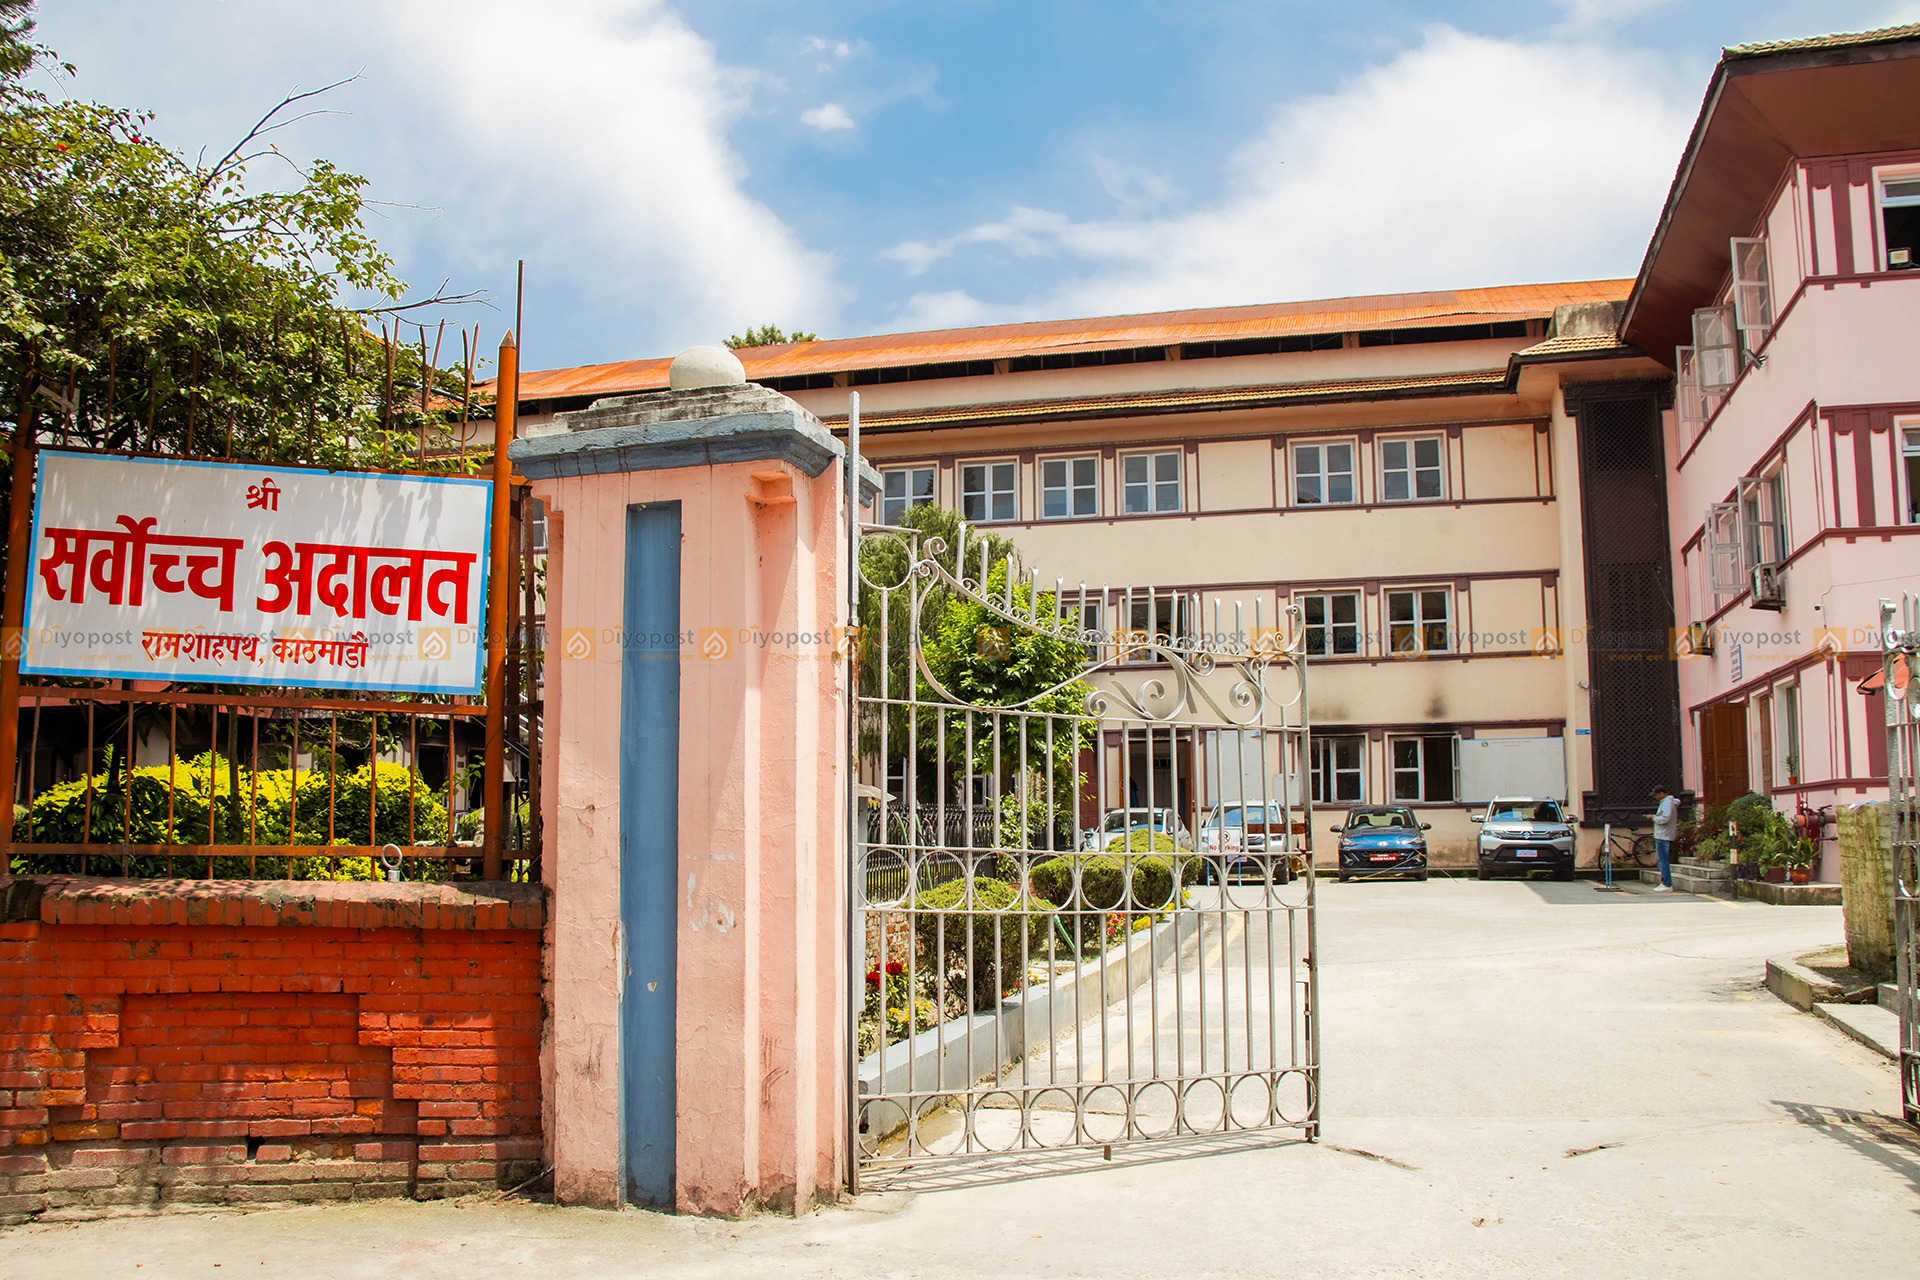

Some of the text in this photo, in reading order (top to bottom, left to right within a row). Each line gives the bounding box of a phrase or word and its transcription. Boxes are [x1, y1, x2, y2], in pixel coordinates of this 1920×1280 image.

[246, 477, 281, 511] श्री
[40, 515, 477, 625] सर्वोच्च अदालत
[141, 631, 264, 667] रामशाहपथ,
